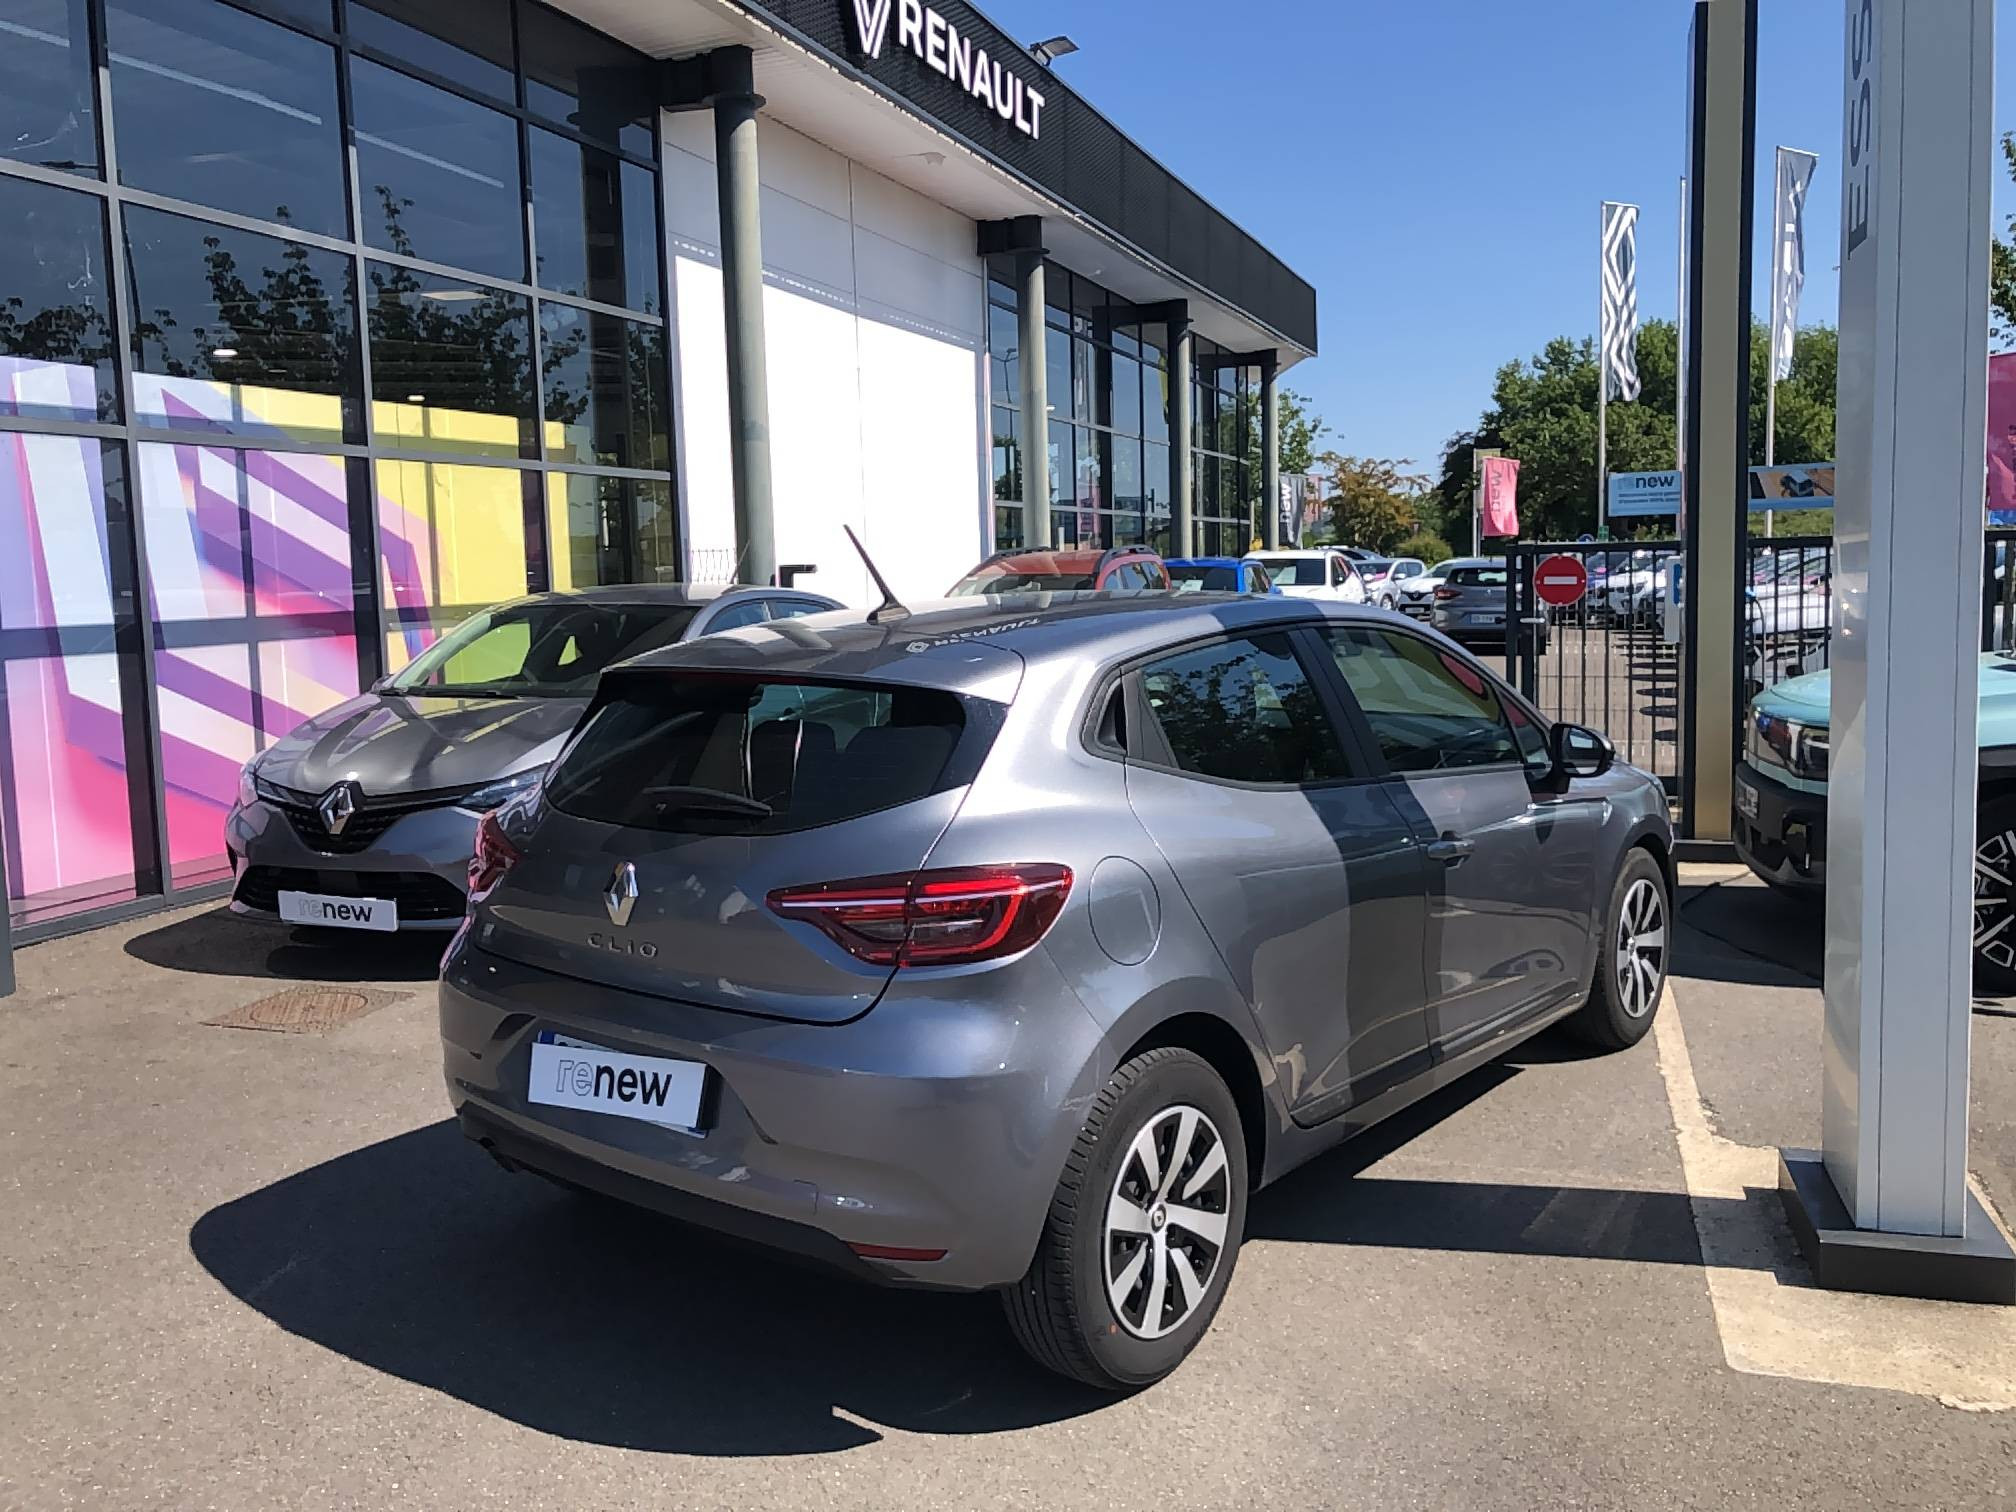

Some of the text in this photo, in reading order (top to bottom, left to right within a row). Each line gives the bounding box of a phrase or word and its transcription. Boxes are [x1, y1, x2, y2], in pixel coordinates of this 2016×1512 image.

[899, 0, 1045, 139] RENAULT
[298, 899, 372, 922] renew
[586, 932, 658, 957] CLIO
[556, 1059, 673, 1107] renew
